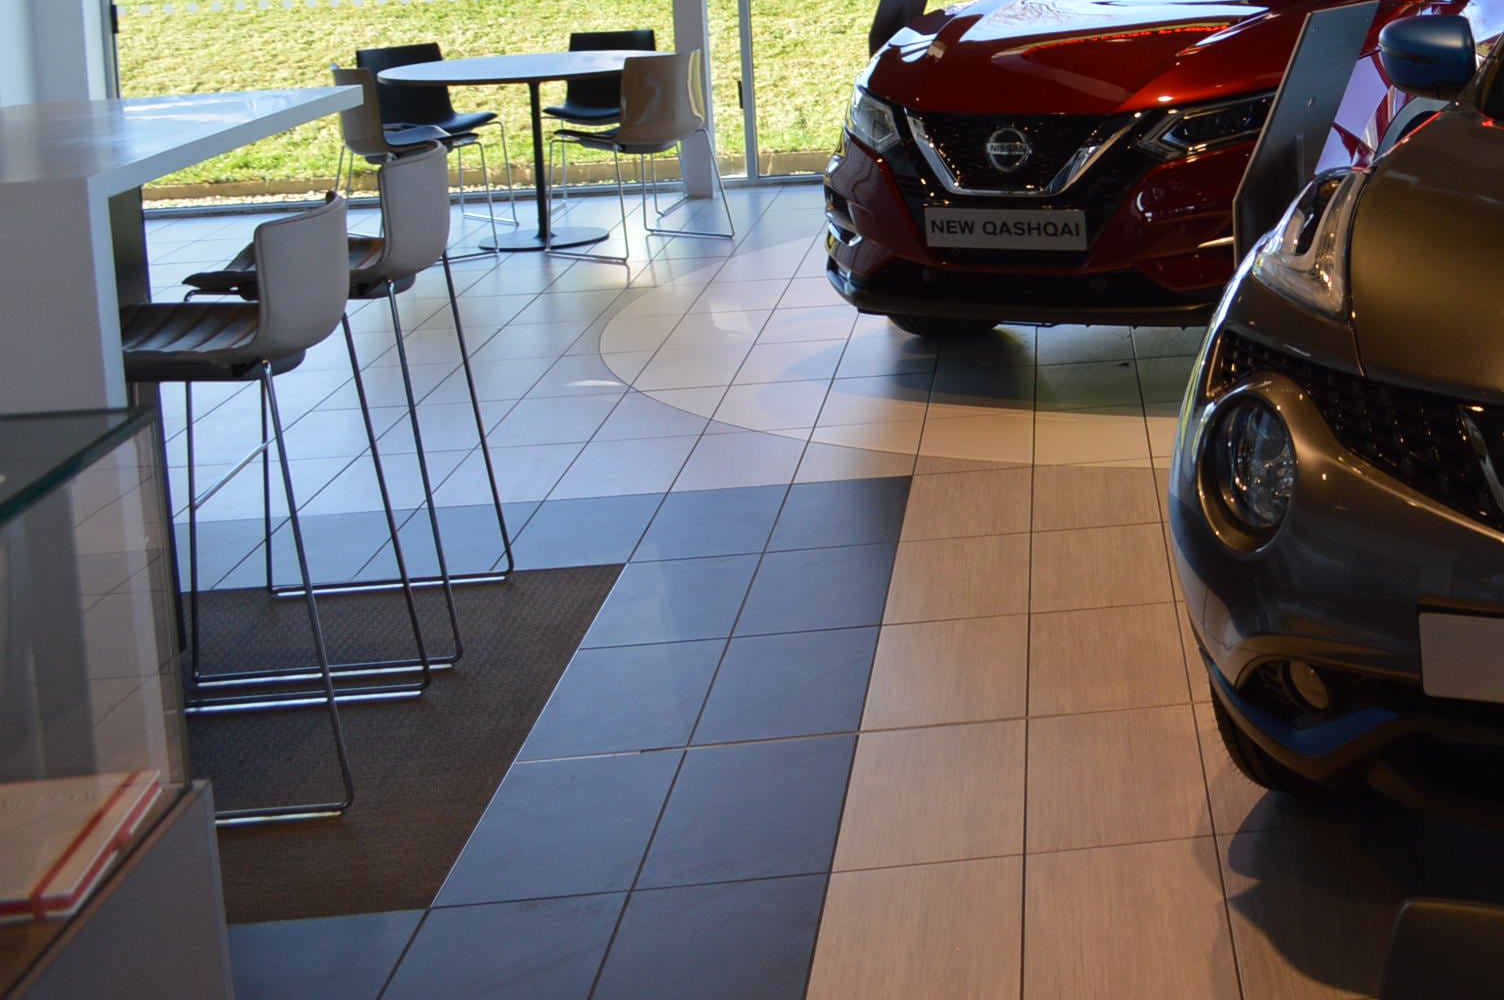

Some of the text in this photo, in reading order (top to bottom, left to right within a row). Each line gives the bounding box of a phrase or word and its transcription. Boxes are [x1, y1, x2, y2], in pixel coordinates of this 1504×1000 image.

[990, 144, 1027, 153] NISSAN
[931, 220, 1080, 237] NEW QASHQAI
